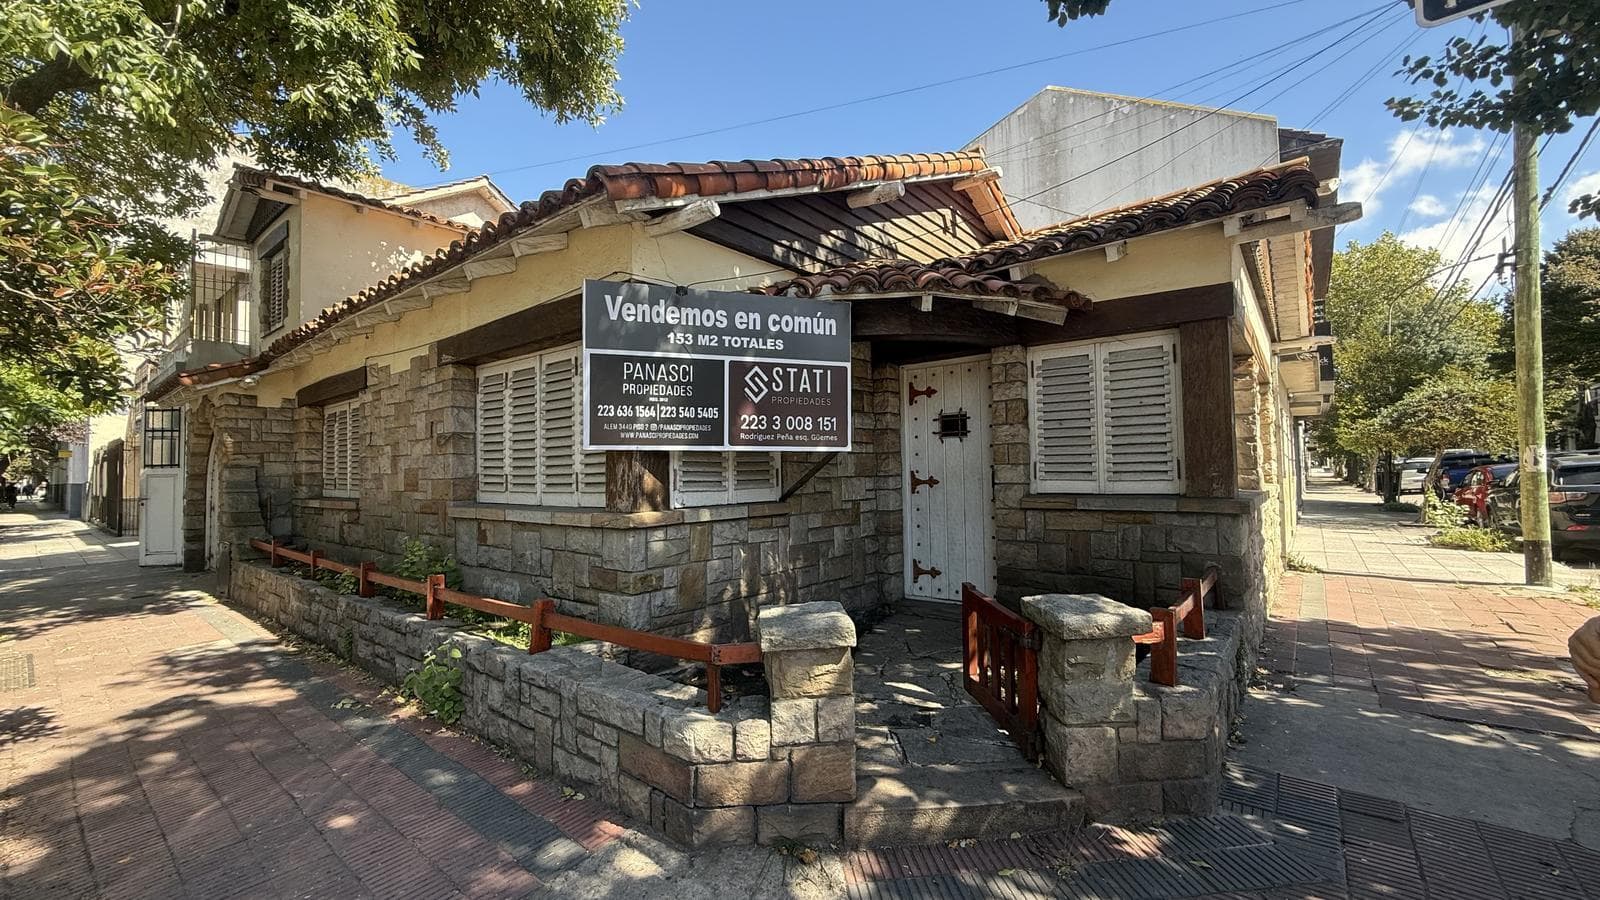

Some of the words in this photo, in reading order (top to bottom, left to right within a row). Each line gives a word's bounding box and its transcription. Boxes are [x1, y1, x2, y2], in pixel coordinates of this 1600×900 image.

[604, 294, 728, 328] Vendemos
[734, 311, 761, 331] en
[768, 311, 837, 336] común
[667, 332, 693, 345] 153
[697, 334, 718, 347] M2
[722, 335, 784, 350] TOTALES
[623, 362, 693, 383] PANASCI
[771, 366, 832, 394] STATI
[622, 383, 693, 397] PROPIEDADES
[771, 396, 832, 406] PROPIEDADES
[597, 404, 614, 417] 223
[616, 405, 633, 417] 636
[635, 405, 656, 418] 1564
[660, 406, 676, 418] 223
[678, 406, 695, 418] 540
[697, 407, 719, 419] 5405
[740, 414, 767, 430] 223
[772, 415, 781, 431] 3
[786, 415, 813, 431] 008
[817, 416, 837, 431] 151
[776, 432, 794, 441] Peña
[795, 434, 808, 442] esq.
[811, 433, 838, 442] Güemes
